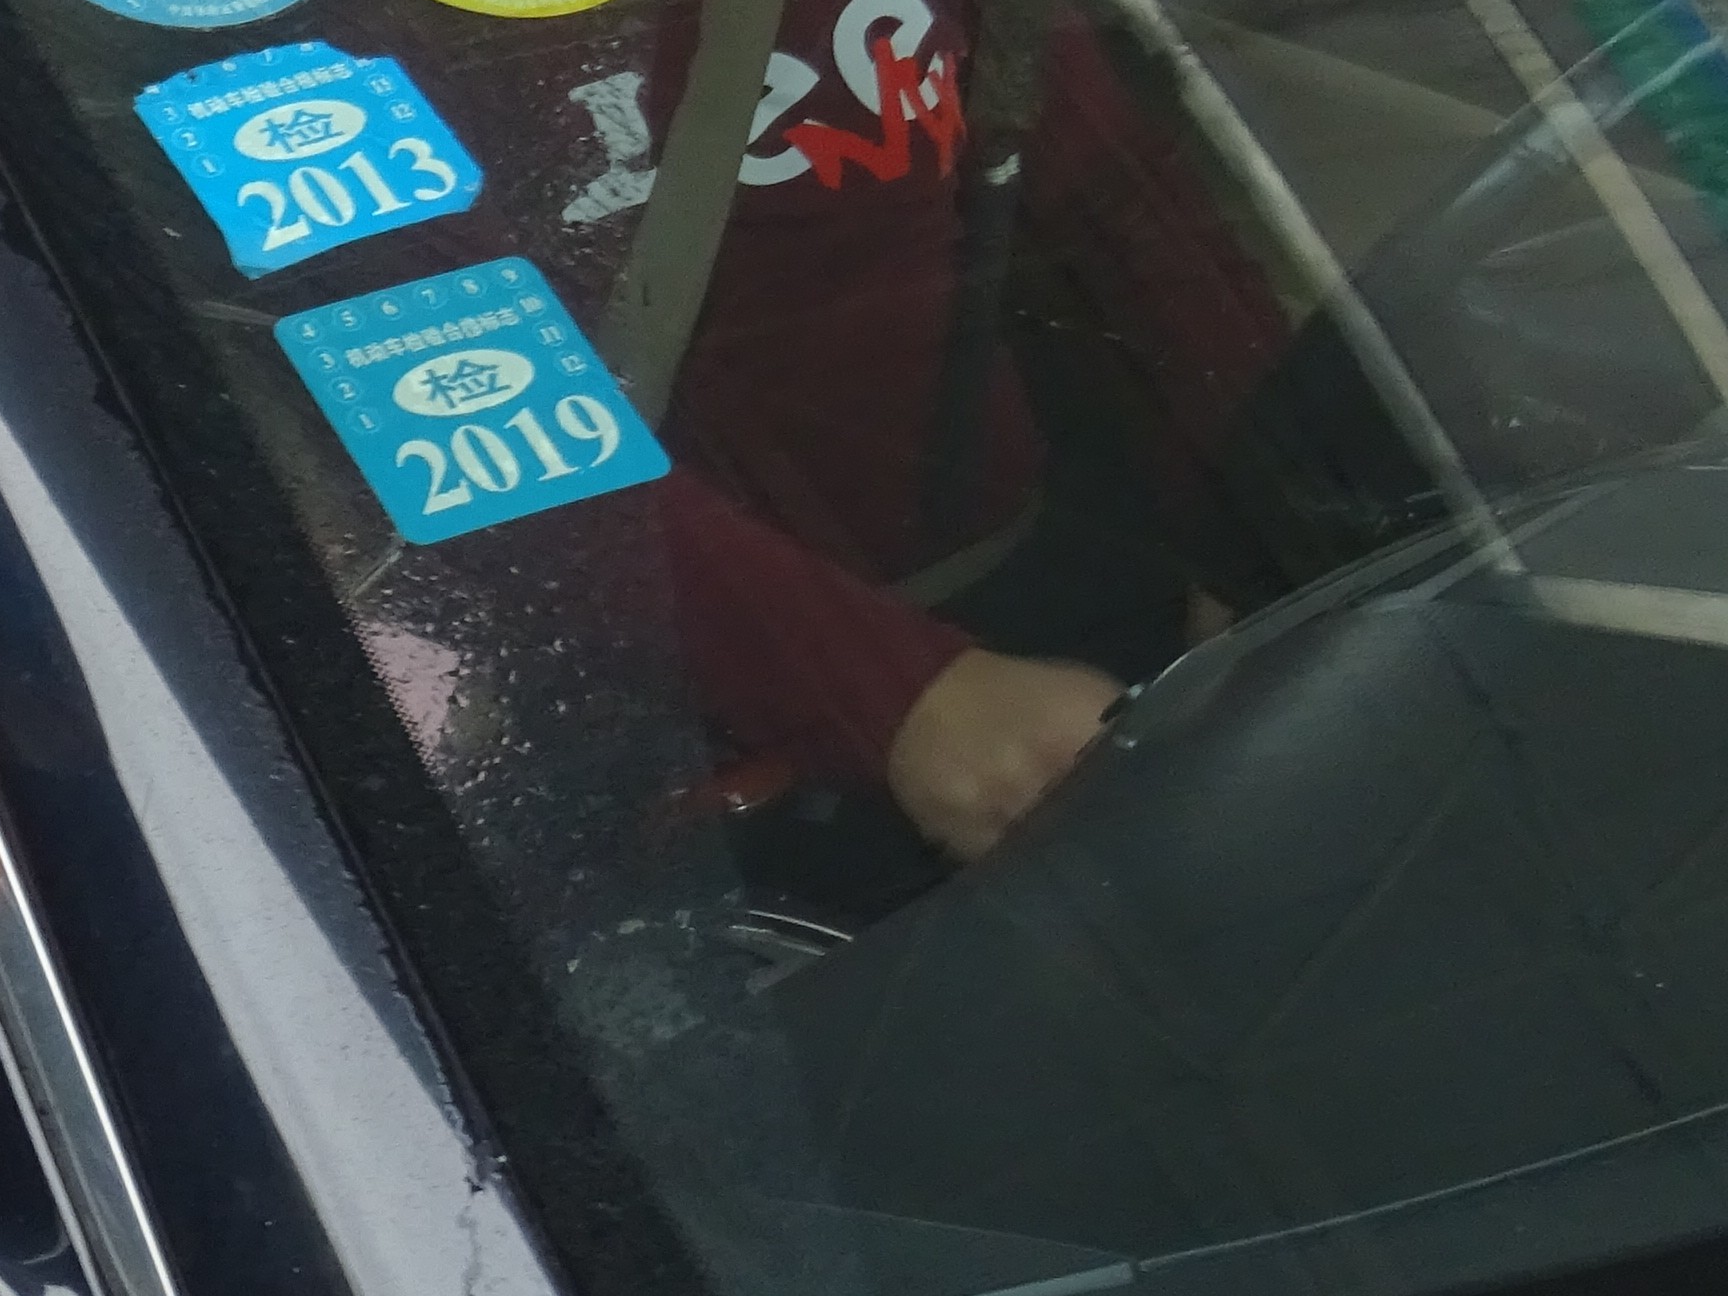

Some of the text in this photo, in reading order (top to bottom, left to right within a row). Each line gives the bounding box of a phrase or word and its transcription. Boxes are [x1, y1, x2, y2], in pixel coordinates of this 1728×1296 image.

[257, 109, 345, 154] 检
[237, 137, 457, 252] 2013
[420, 359, 512, 409] 检
[395, 394, 621, 516] 2019
